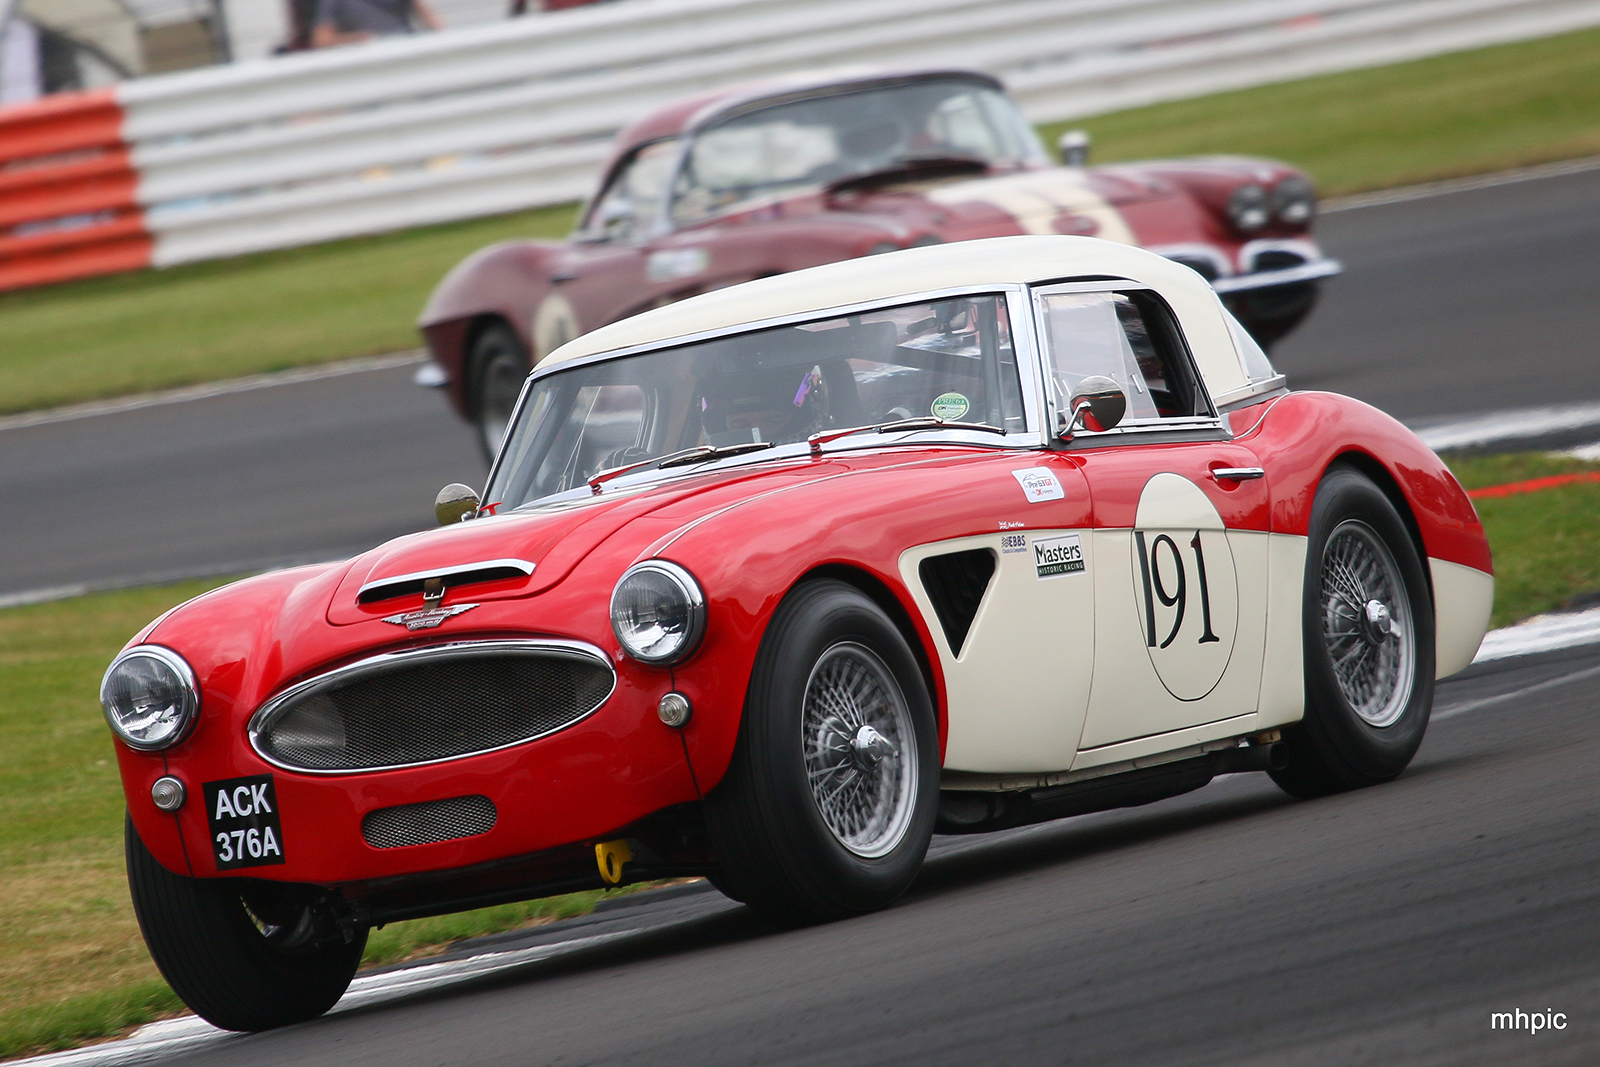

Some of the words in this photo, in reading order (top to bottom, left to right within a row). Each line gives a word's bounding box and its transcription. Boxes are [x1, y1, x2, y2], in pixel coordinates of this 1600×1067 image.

[1009, 535, 1025, 548] EBBS
[1034, 545, 1081, 564] Masters
[1039, 565, 1062, 575] HISTORIC
[1063, 562, 1083, 571] RACING
[1135, 529, 1220, 649] 191
[216, 783, 272, 820] ACK
[216, 826, 280, 862] 376A
